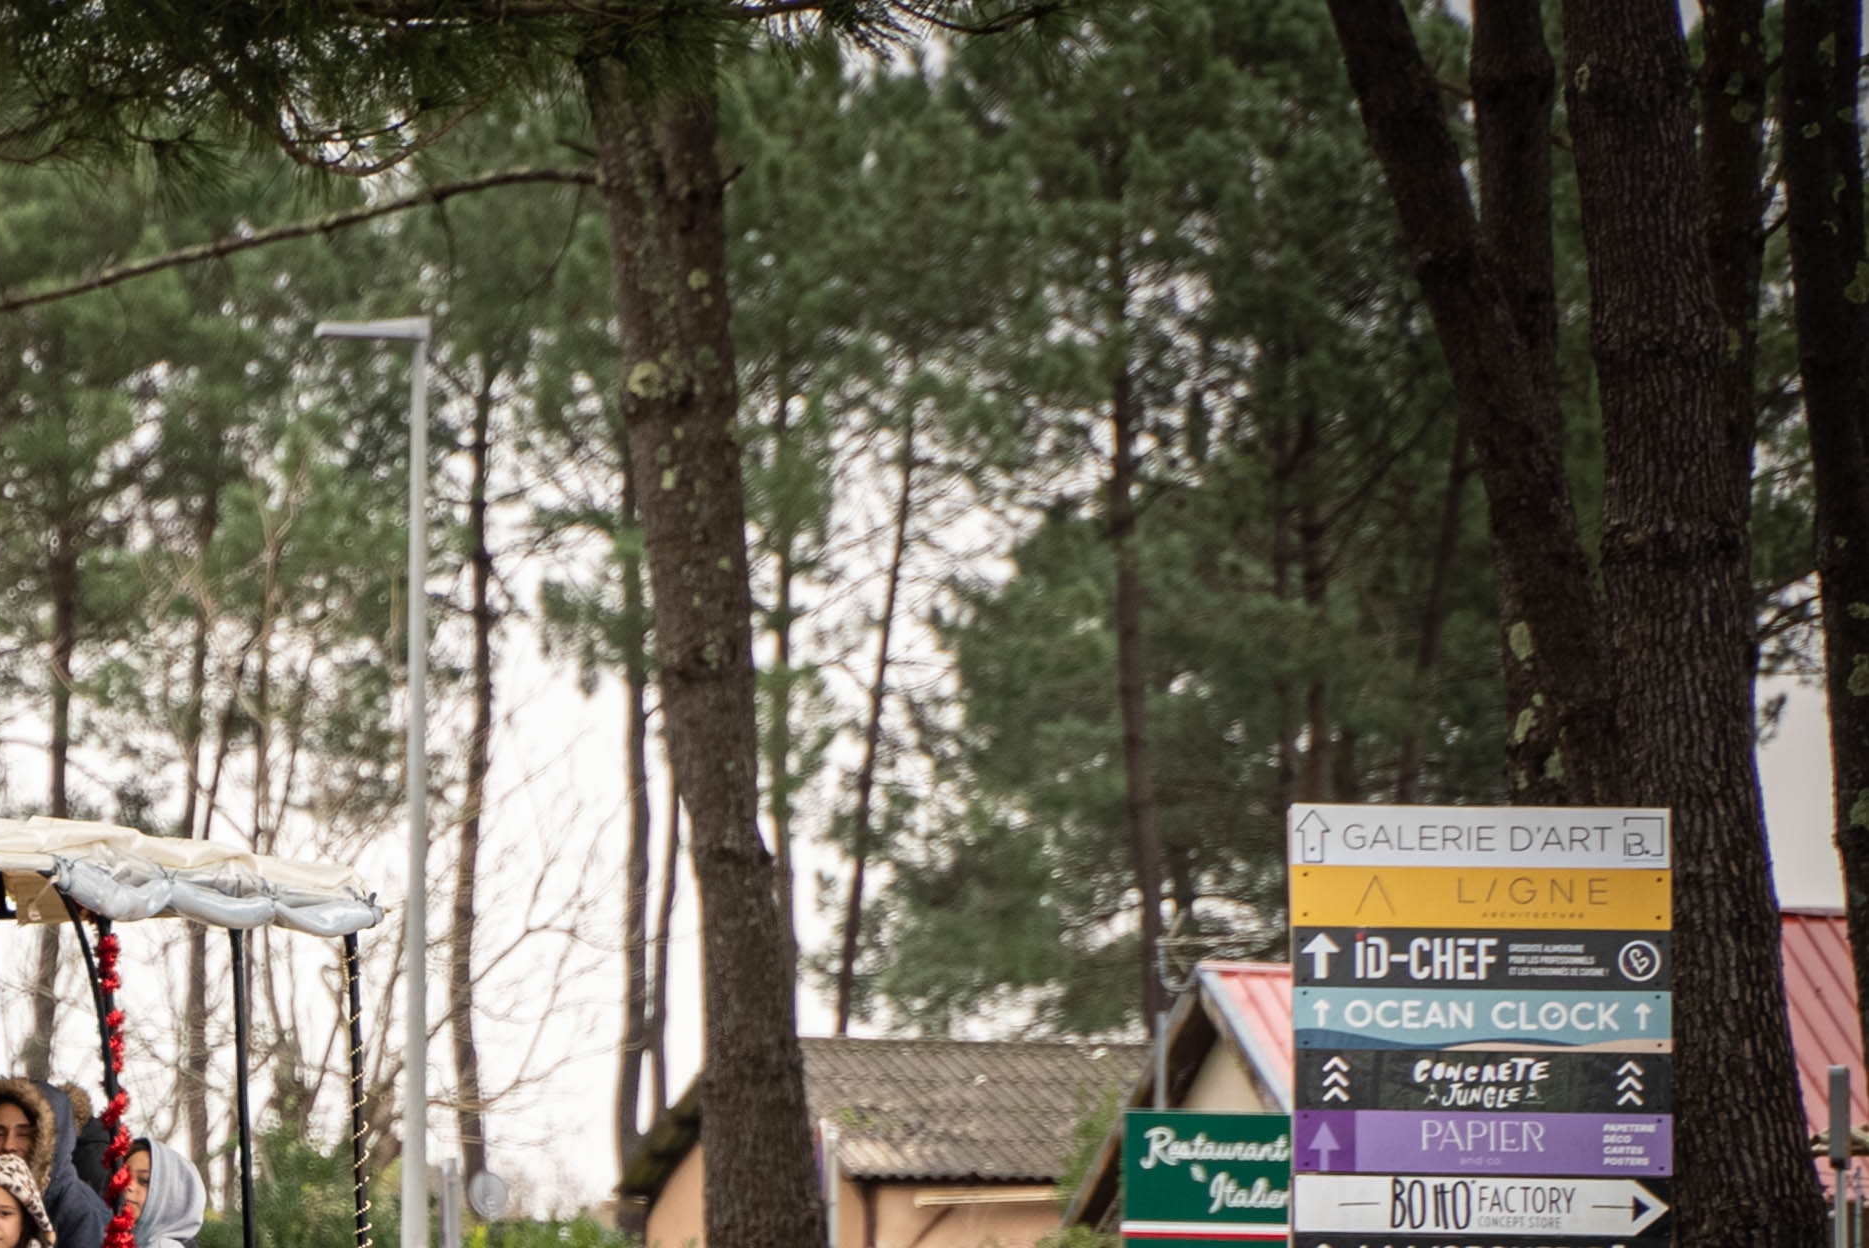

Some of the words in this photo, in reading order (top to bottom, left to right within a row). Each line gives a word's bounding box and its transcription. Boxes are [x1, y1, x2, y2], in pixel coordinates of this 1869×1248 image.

[1342, 823, 1496, 852] GALERIE
[1510, 825, 1612, 853] D'ART
[1343, 1000, 1475, 1029] OCEAN
[1490, 1001, 1620, 1032] CLOCK
[1412, 1057, 1551, 1084] CONCRETE
[1441, 1083, 1523, 1109] JUNGLE
[1421, 1119, 1546, 1152] PAPIER
[1603, 1123, 1656, 1133] PAPETERIE
[1139, 1126, 1290, 1169] Restaurant
[1603, 1157, 1650, 1167] POSTERS
[1390, 1177, 1472, 1230] BOHO
[1477, 1185, 1577, 1216] FACTORY
[1477, 1216, 1526, 1229] CONCEPT
[1529, 1216, 1562, 1230] STORE
